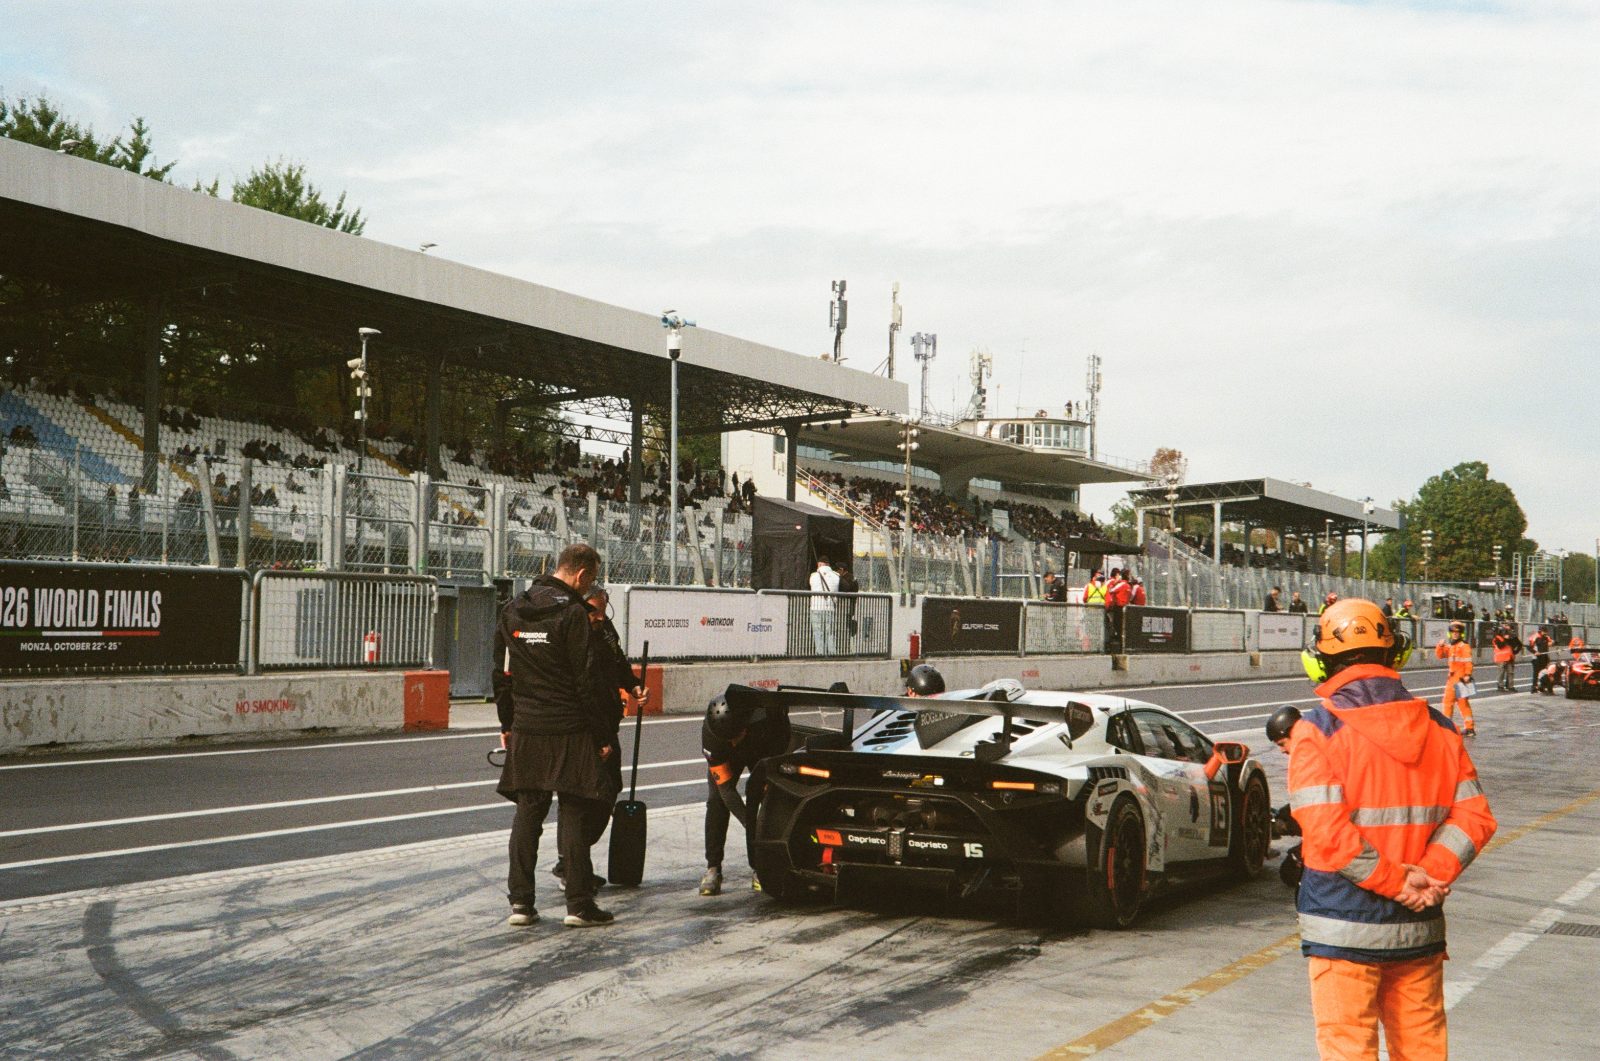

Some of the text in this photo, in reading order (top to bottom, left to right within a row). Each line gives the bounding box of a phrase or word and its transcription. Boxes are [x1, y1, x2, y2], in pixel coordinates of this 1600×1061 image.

[0, 586, 162, 628] 26 WORLD FINALS
[644, 619, 689, 628] ROGER DUBUIS
[747, 622, 772, 632] Fastron
[20, 642, 53, 652] MONZA,
[54, 642, 91, 651] OCTOBER
[236, 700, 250, 713] NO
[963, 842, 984, 858] 15
